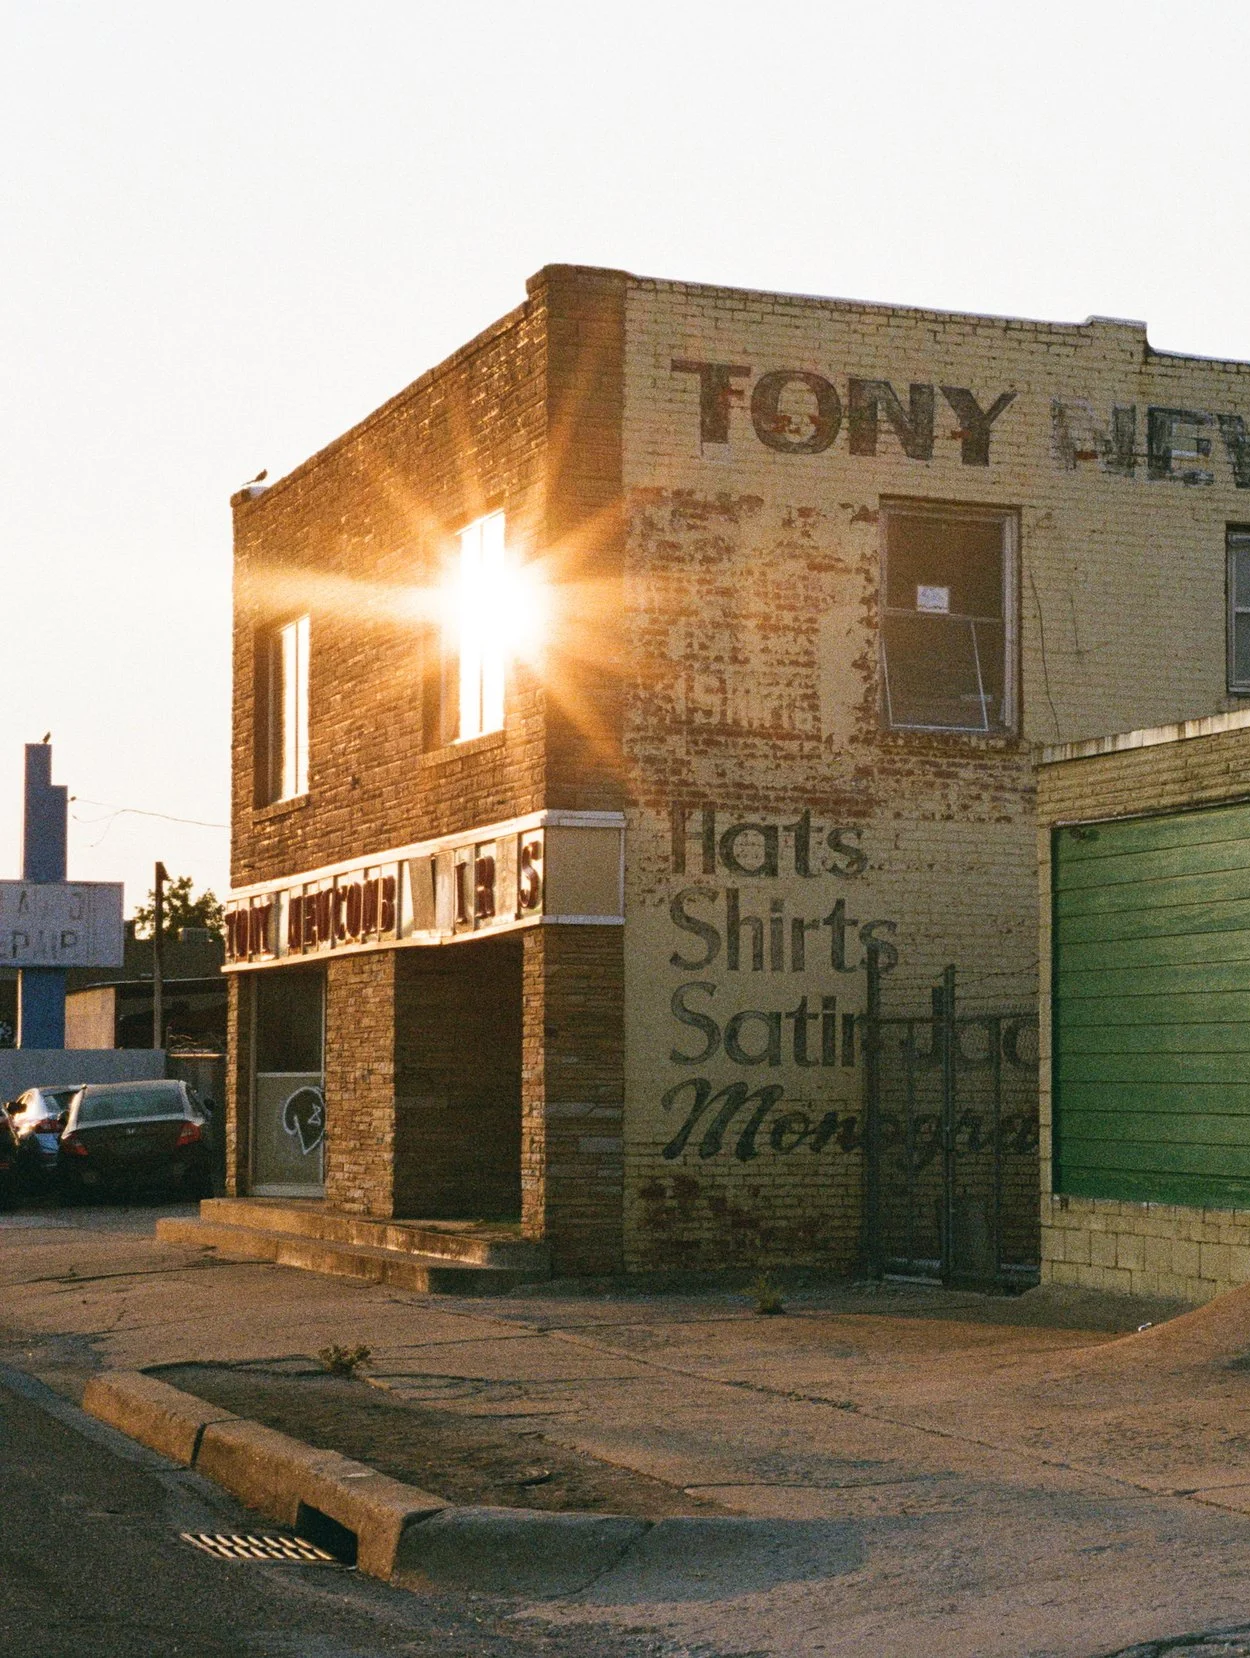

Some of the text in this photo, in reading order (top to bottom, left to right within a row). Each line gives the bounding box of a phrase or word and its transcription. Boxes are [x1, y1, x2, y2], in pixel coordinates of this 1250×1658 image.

[671, 359, 1018, 467] TONY
[670, 800, 869, 879] Hats
[669, 886, 899, 974] Shirts
